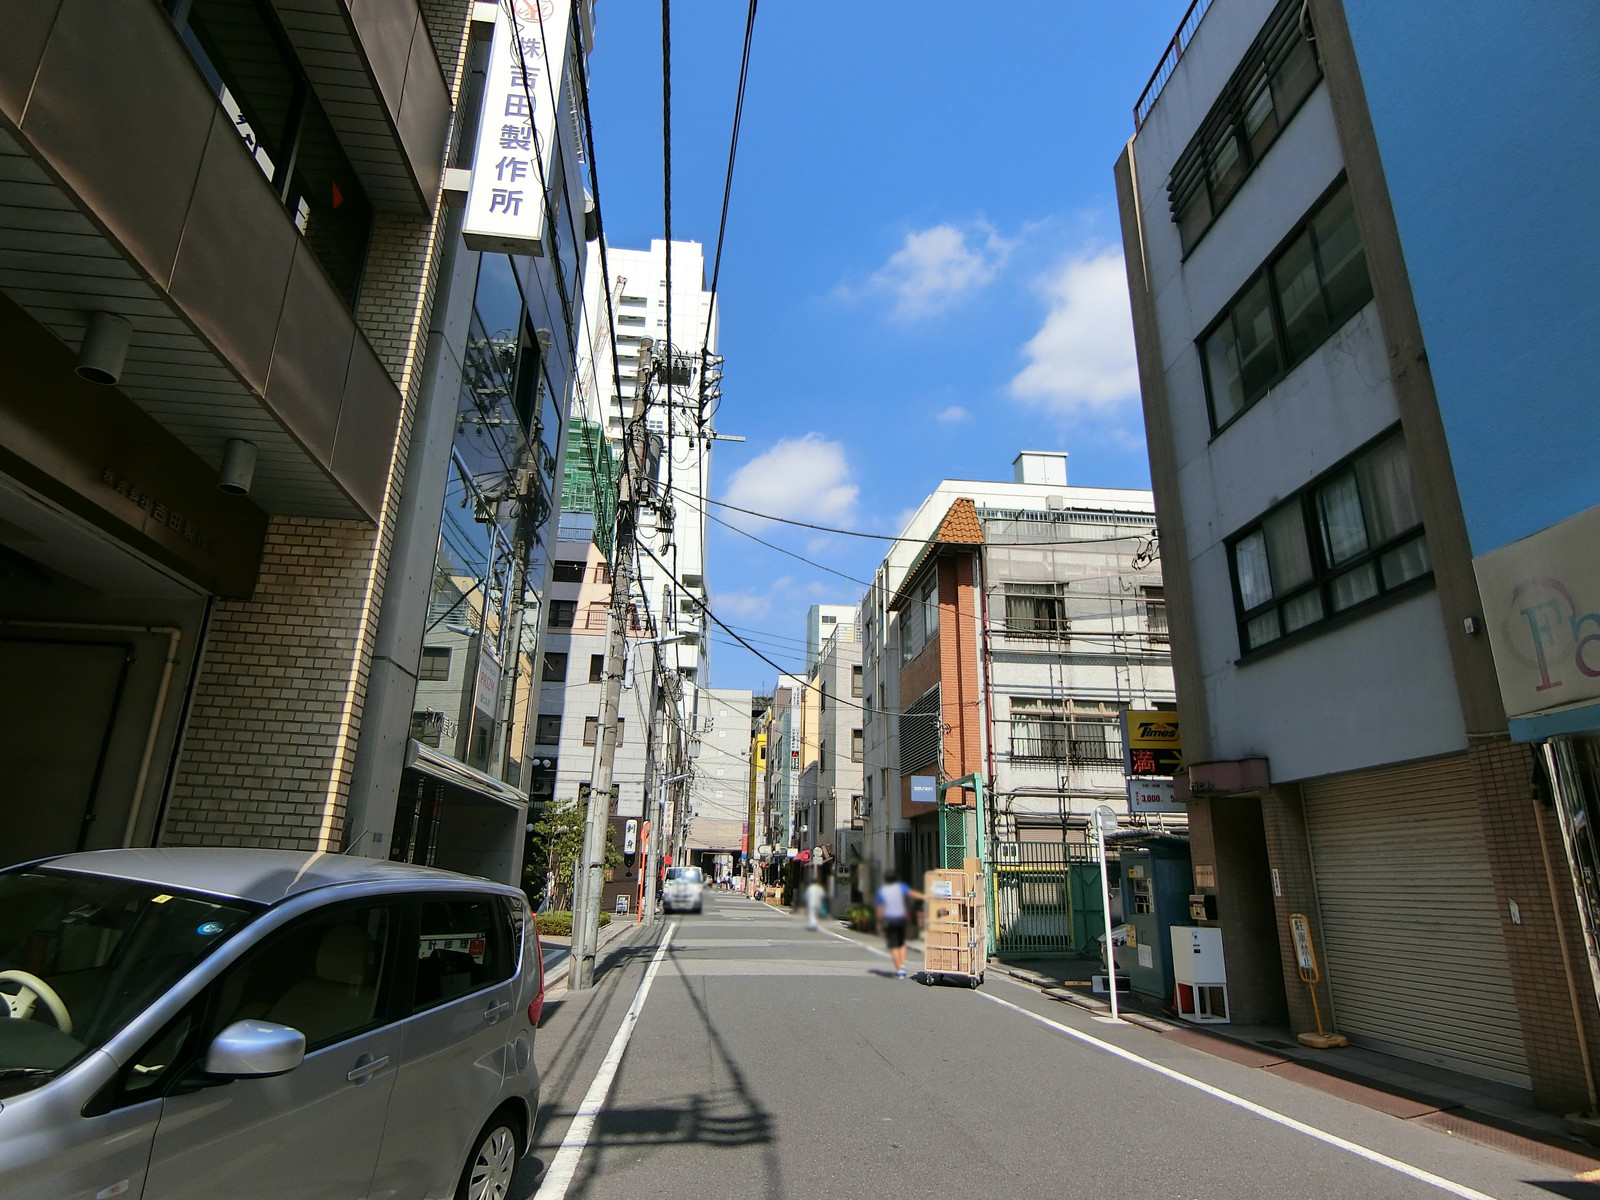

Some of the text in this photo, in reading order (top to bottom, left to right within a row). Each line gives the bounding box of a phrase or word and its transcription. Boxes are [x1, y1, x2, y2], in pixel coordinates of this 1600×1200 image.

[1138, 722, 1179, 739] Times
[1133, 750, 1156, 774] 満
[1141, 794, 1161, 804] 3,000
